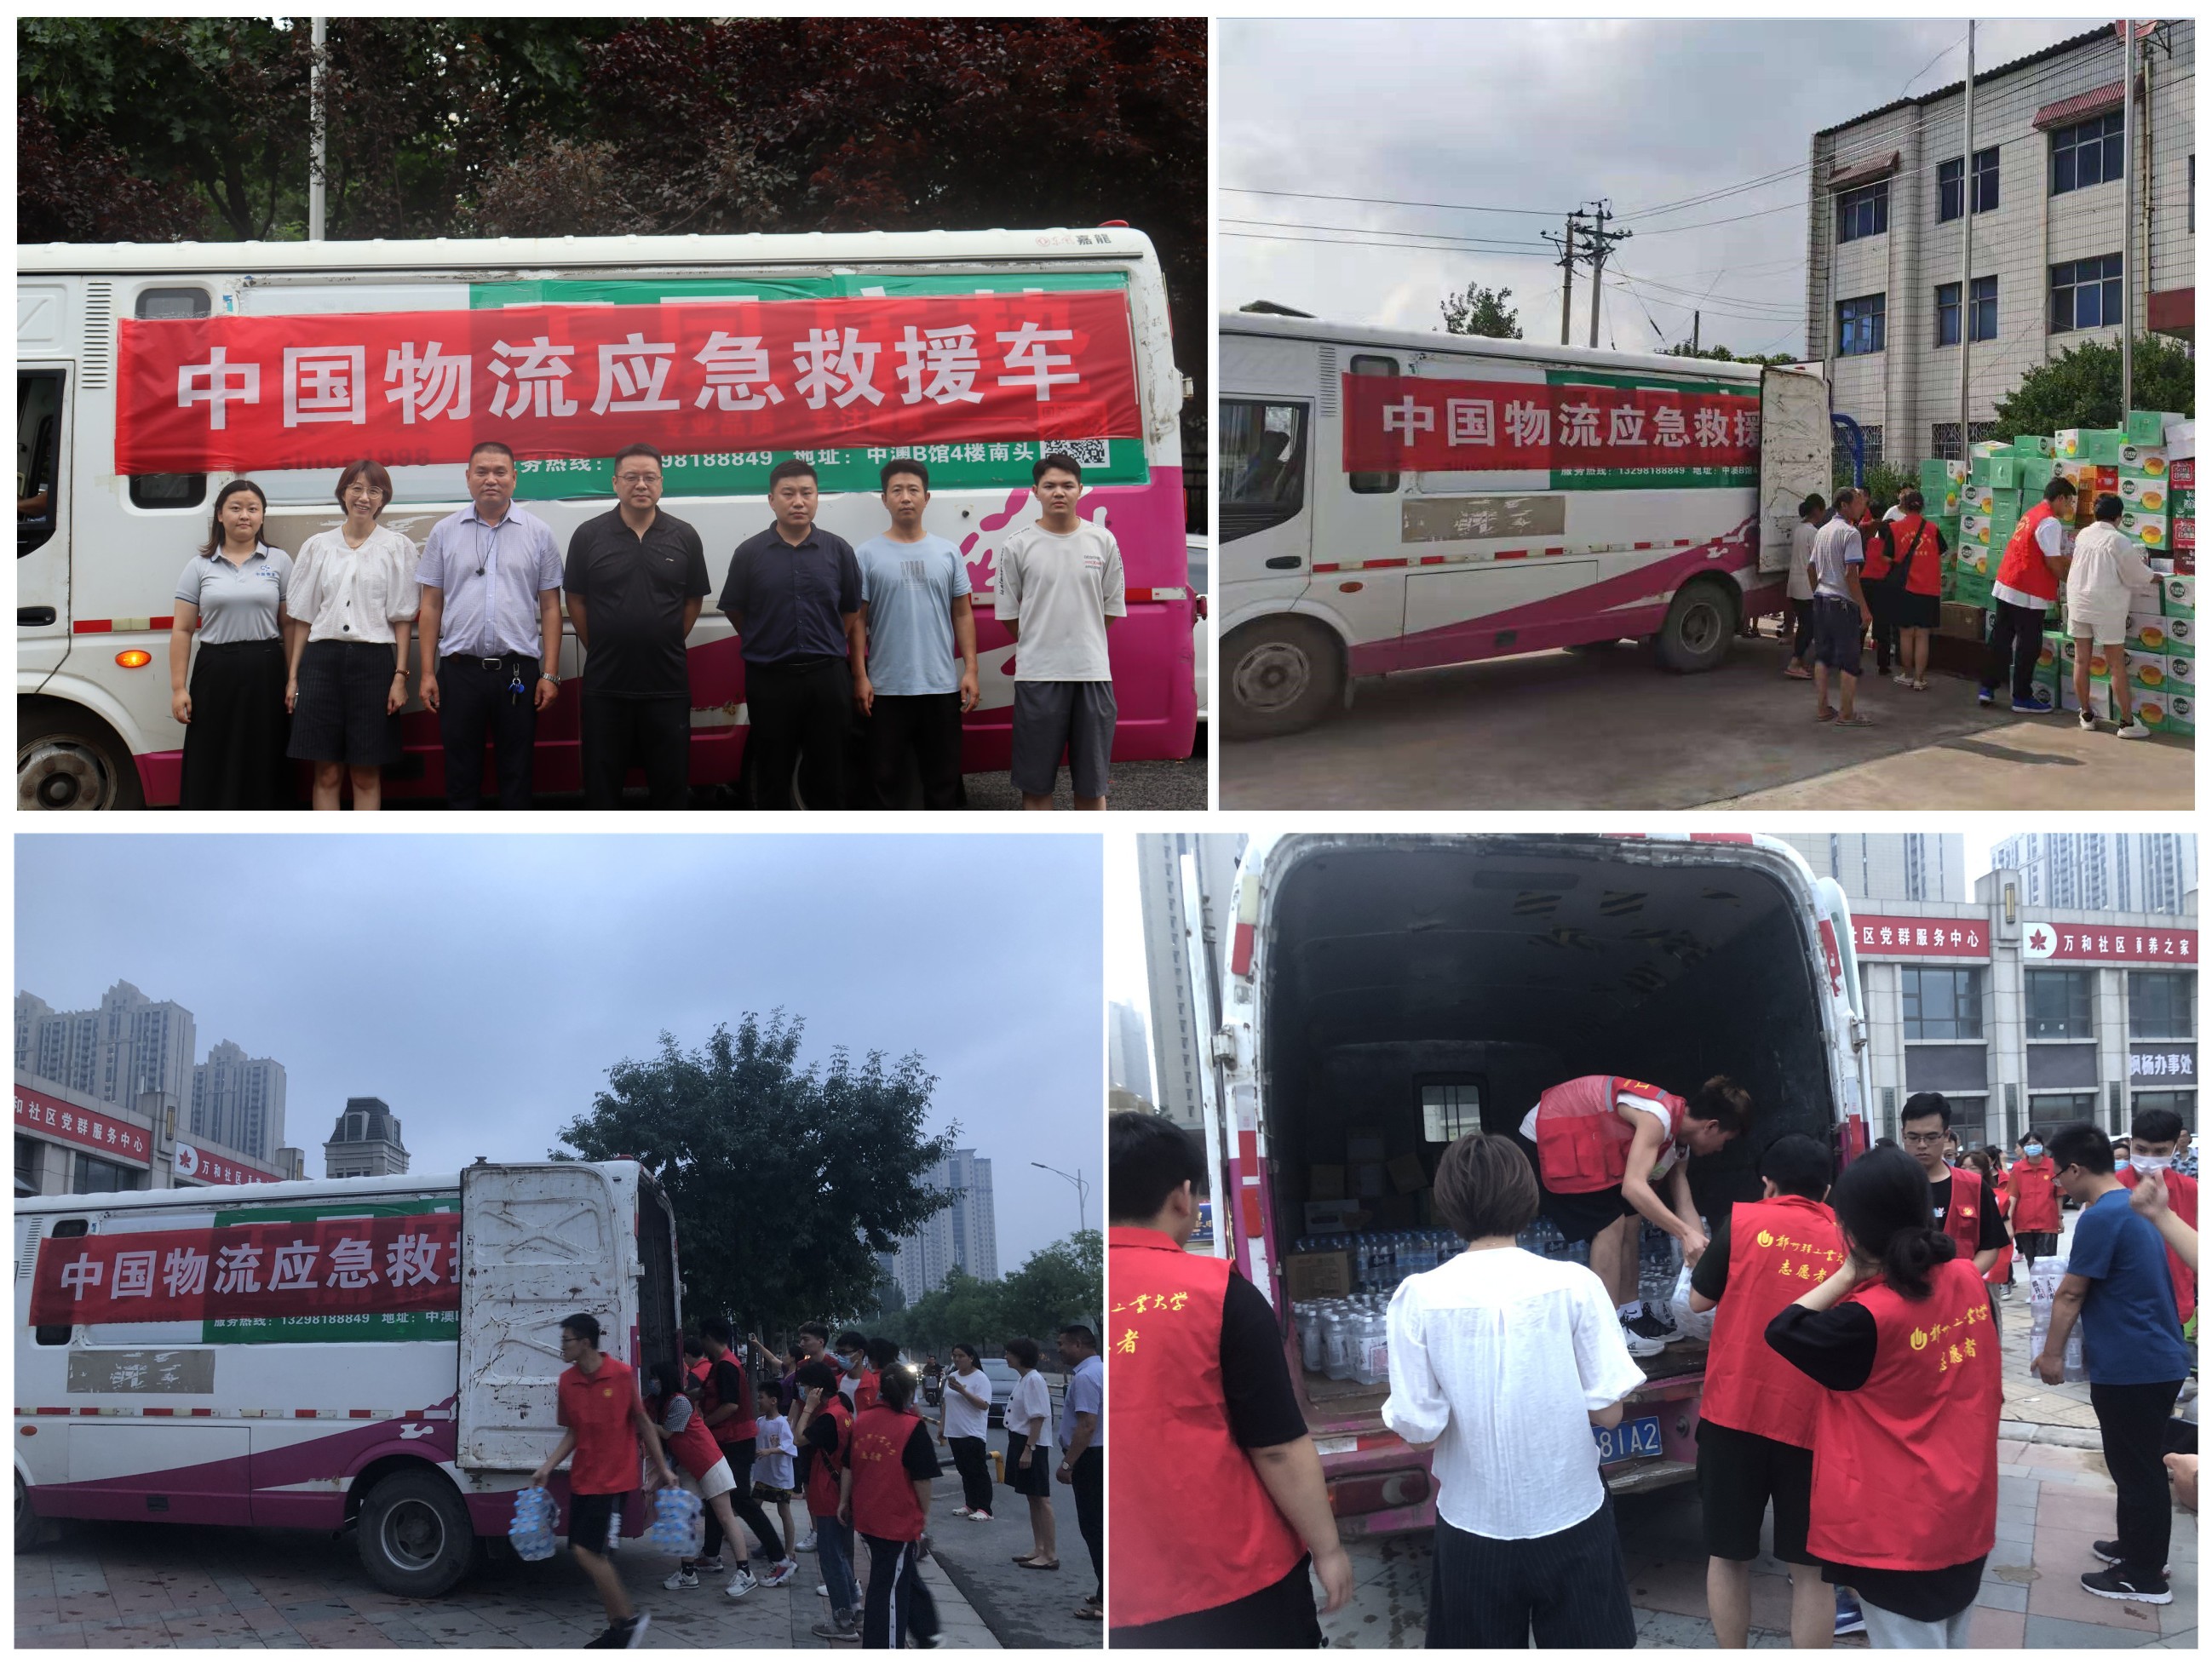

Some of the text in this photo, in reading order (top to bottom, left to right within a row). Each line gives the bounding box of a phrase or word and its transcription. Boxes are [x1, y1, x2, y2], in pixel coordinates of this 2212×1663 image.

[177, 322, 1082, 430] 中国物流应急救援车
[60, 1232, 461, 1302] 中国物流应急救
[1778, 1259, 1827, 1283] 志愿者
[282, 1313, 370, 1325] 13298188849
[382, 1312, 415, 1323] 地址：
[1596, 1423, 1658, 1459] 81A2
